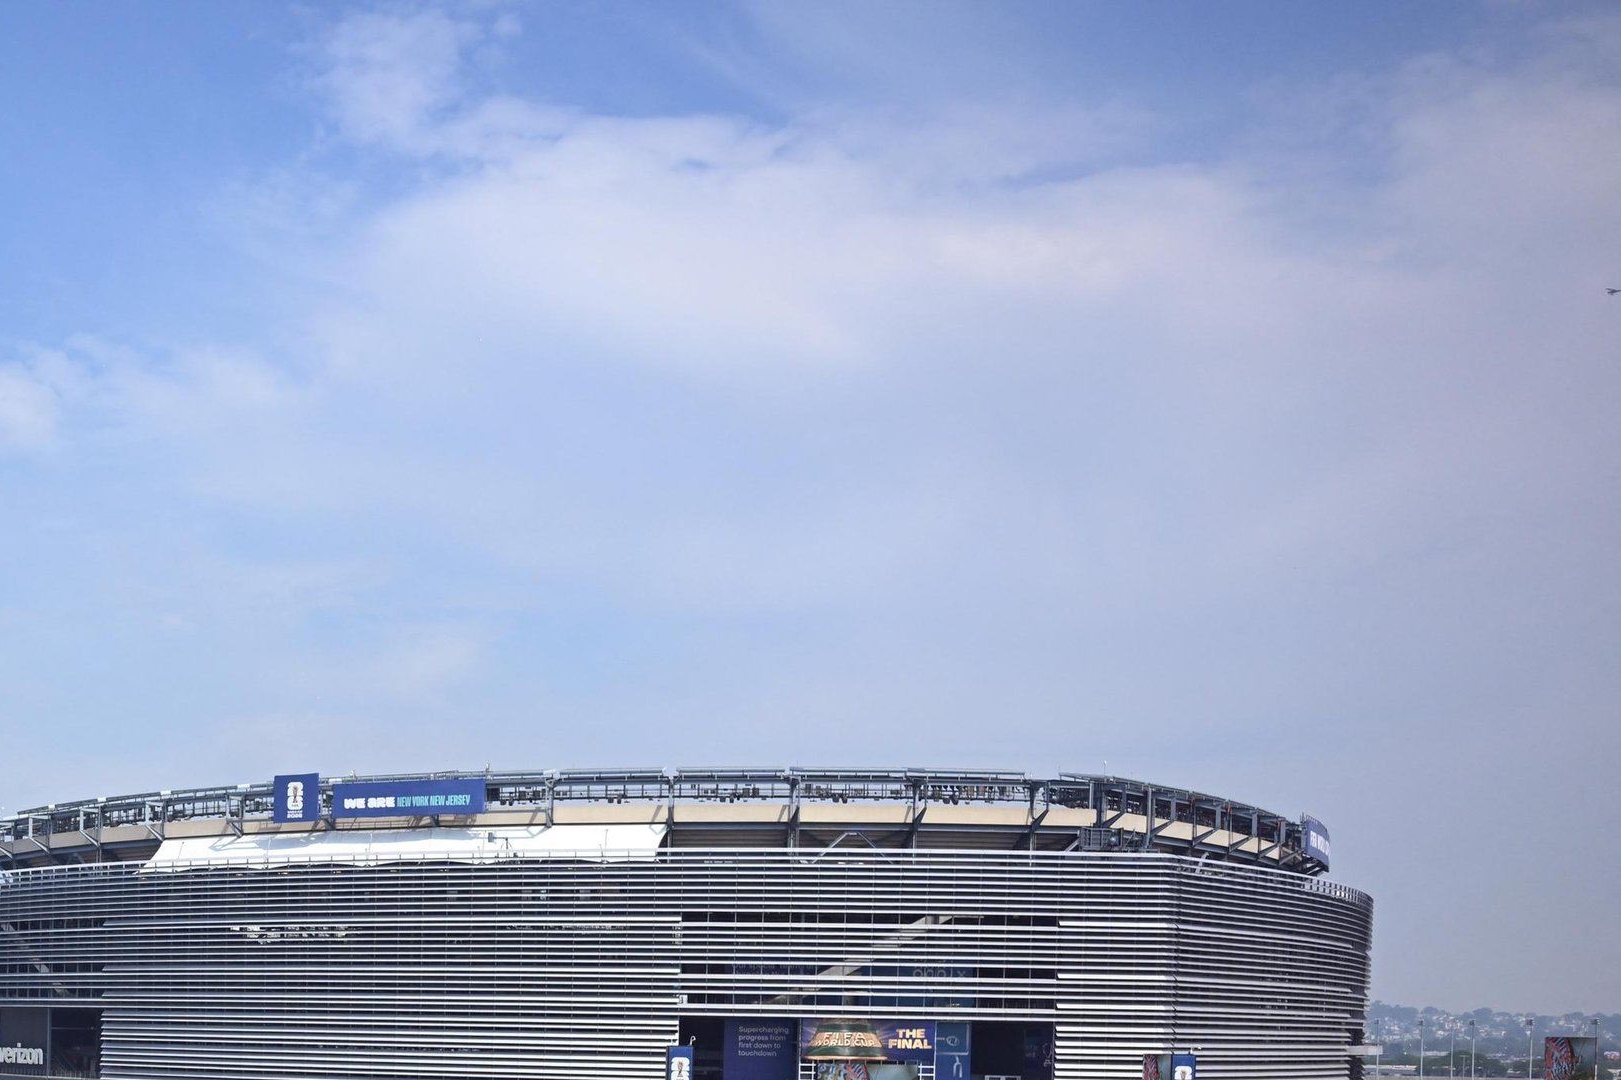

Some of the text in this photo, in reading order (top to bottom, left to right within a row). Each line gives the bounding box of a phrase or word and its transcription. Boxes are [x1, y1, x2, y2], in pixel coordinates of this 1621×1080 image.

[397, 796, 412, 807] NEW
[412, 795, 429, 806] YORK
[430, 794, 445, 806] NEW
[446, 794, 470, 806] JERSEY
[739, 1026, 789, 1034] Supercharging
[897, 1028, 925, 1038] THE
[738, 1034, 768, 1042] progress
[824, 1032, 865, 1040] FIFA
[888, 1038, 932, 1049] FINAL
